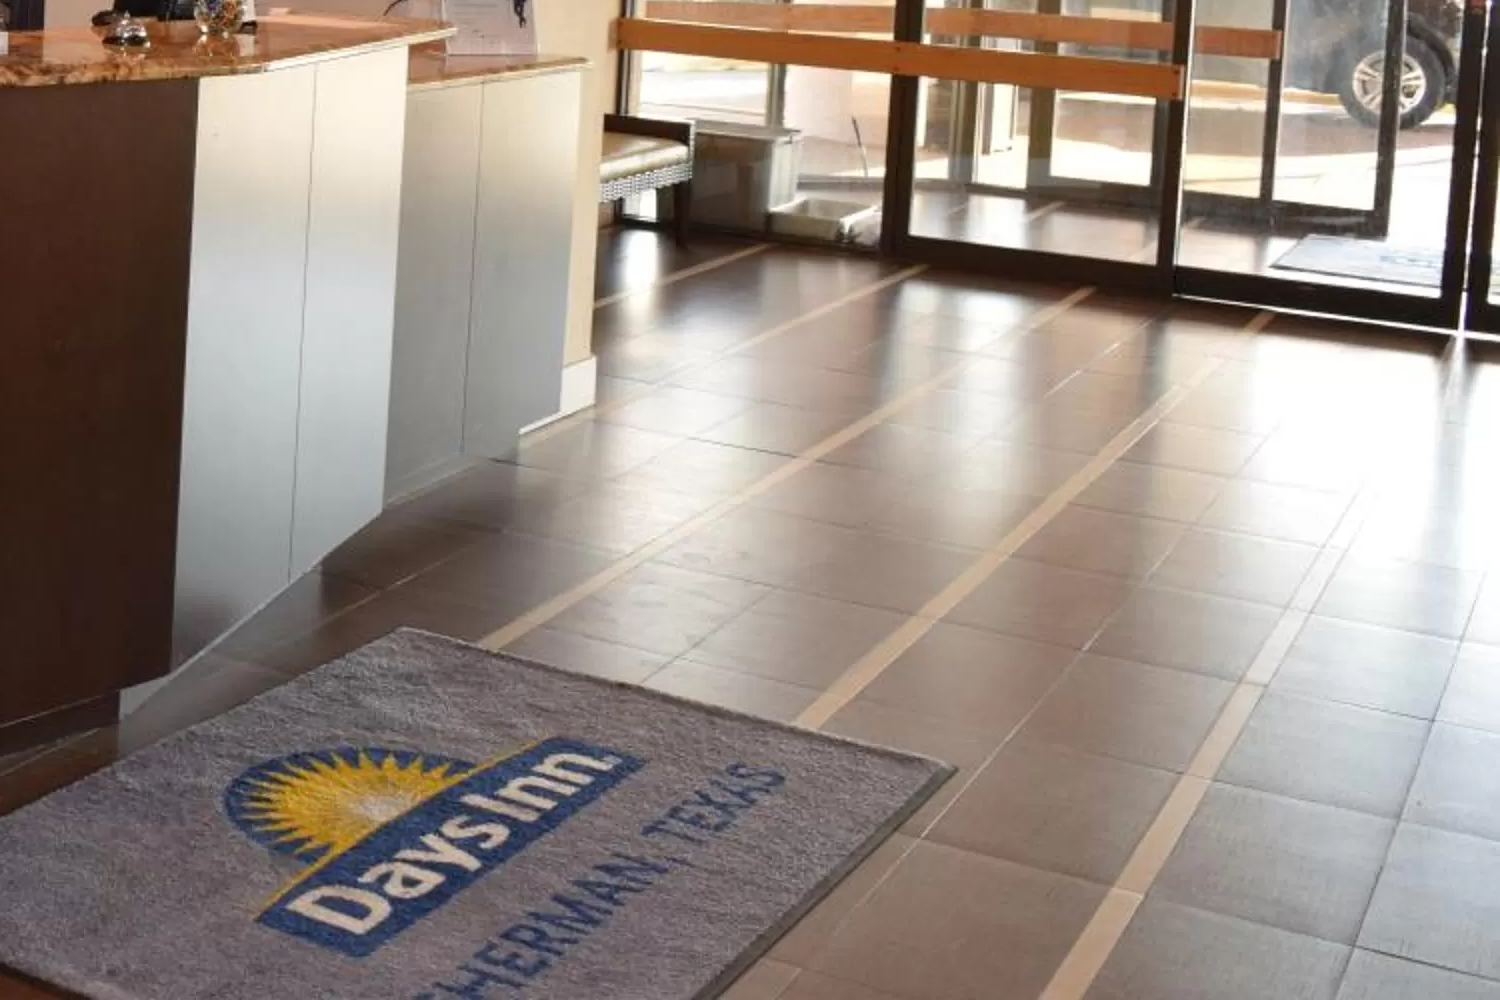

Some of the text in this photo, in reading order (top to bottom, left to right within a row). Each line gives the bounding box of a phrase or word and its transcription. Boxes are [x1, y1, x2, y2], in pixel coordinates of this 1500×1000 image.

[284, 752, 616, 936] Days Inn
[413, 761, 787, 1000] HERMAN, TEXAS
